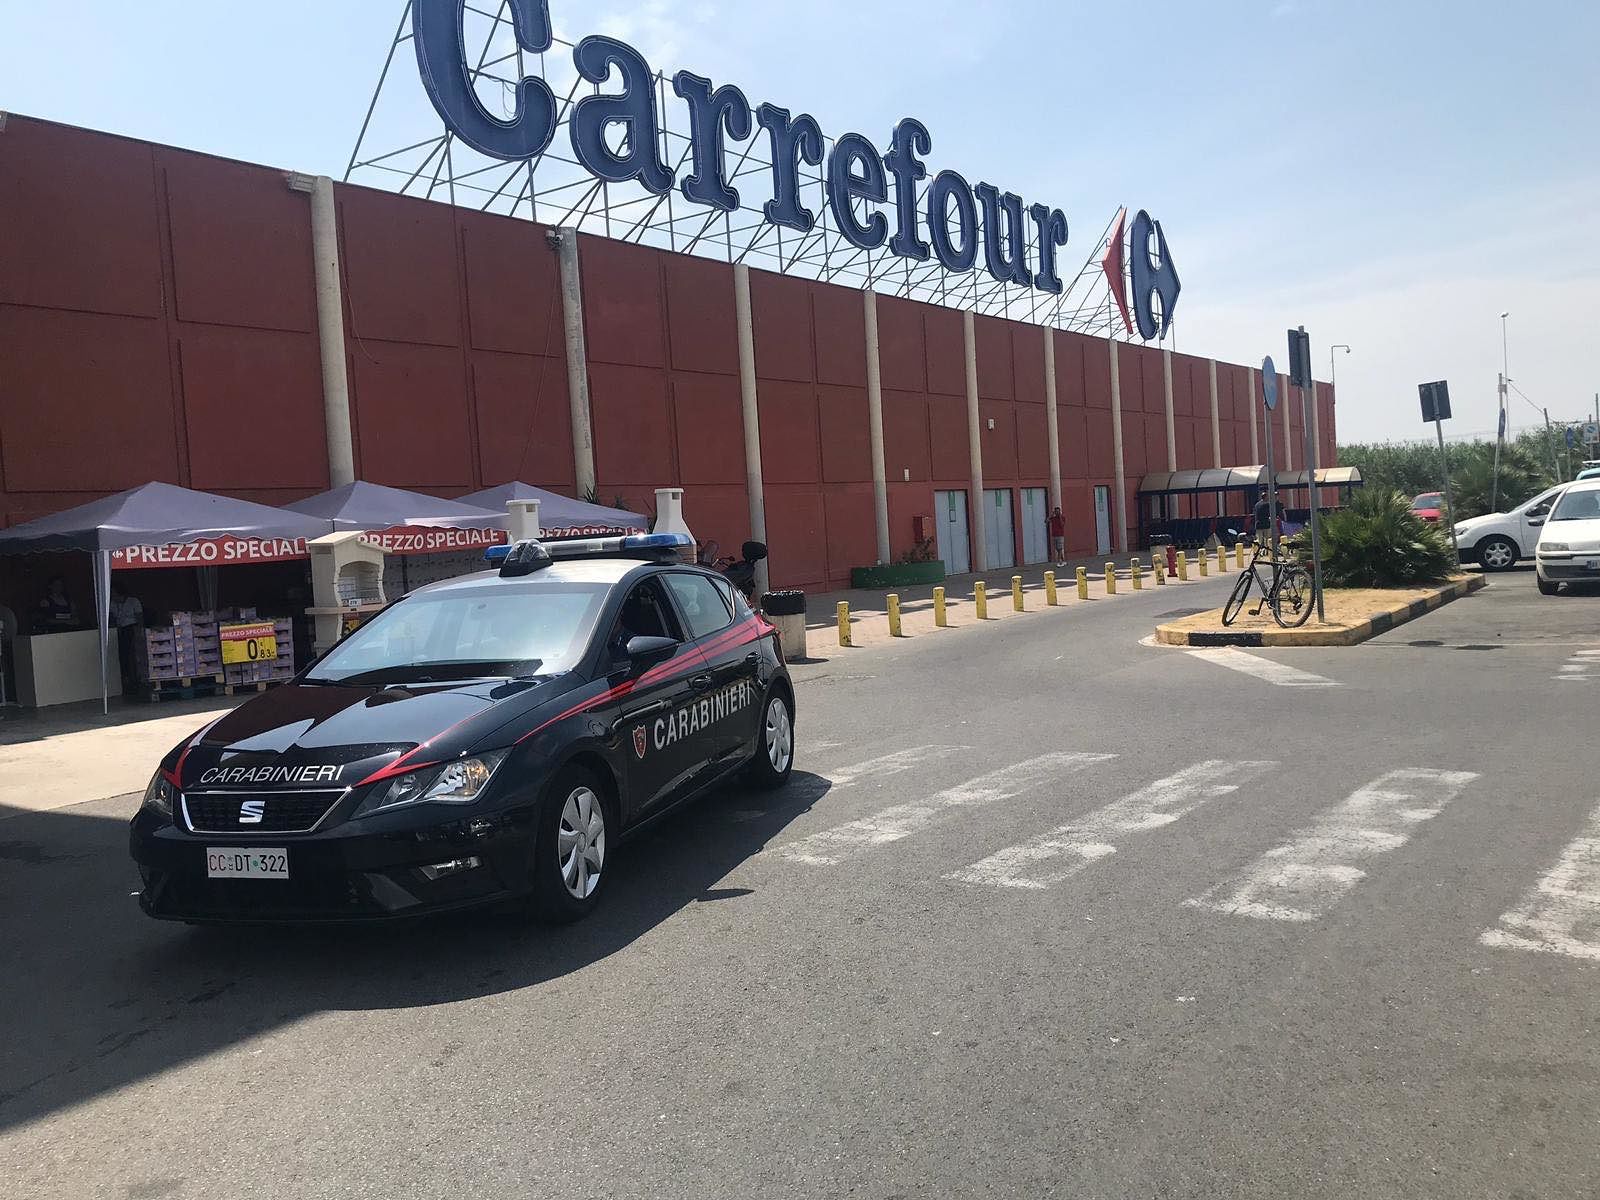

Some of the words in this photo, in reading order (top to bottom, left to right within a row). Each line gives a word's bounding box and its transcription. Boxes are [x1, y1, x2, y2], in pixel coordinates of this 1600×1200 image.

[412, 0, 1068, 294] Carrefour
[426, 529, 500, 548] SPECIALE
[126, 542, 217, 563] PREZZO
[248, 639, 258, 659] 0
[654, 680, 750, 750] CARABINIERI
[200, 765, 345, 783] CARABINIERI
[259, 855, 287, 872] 322
